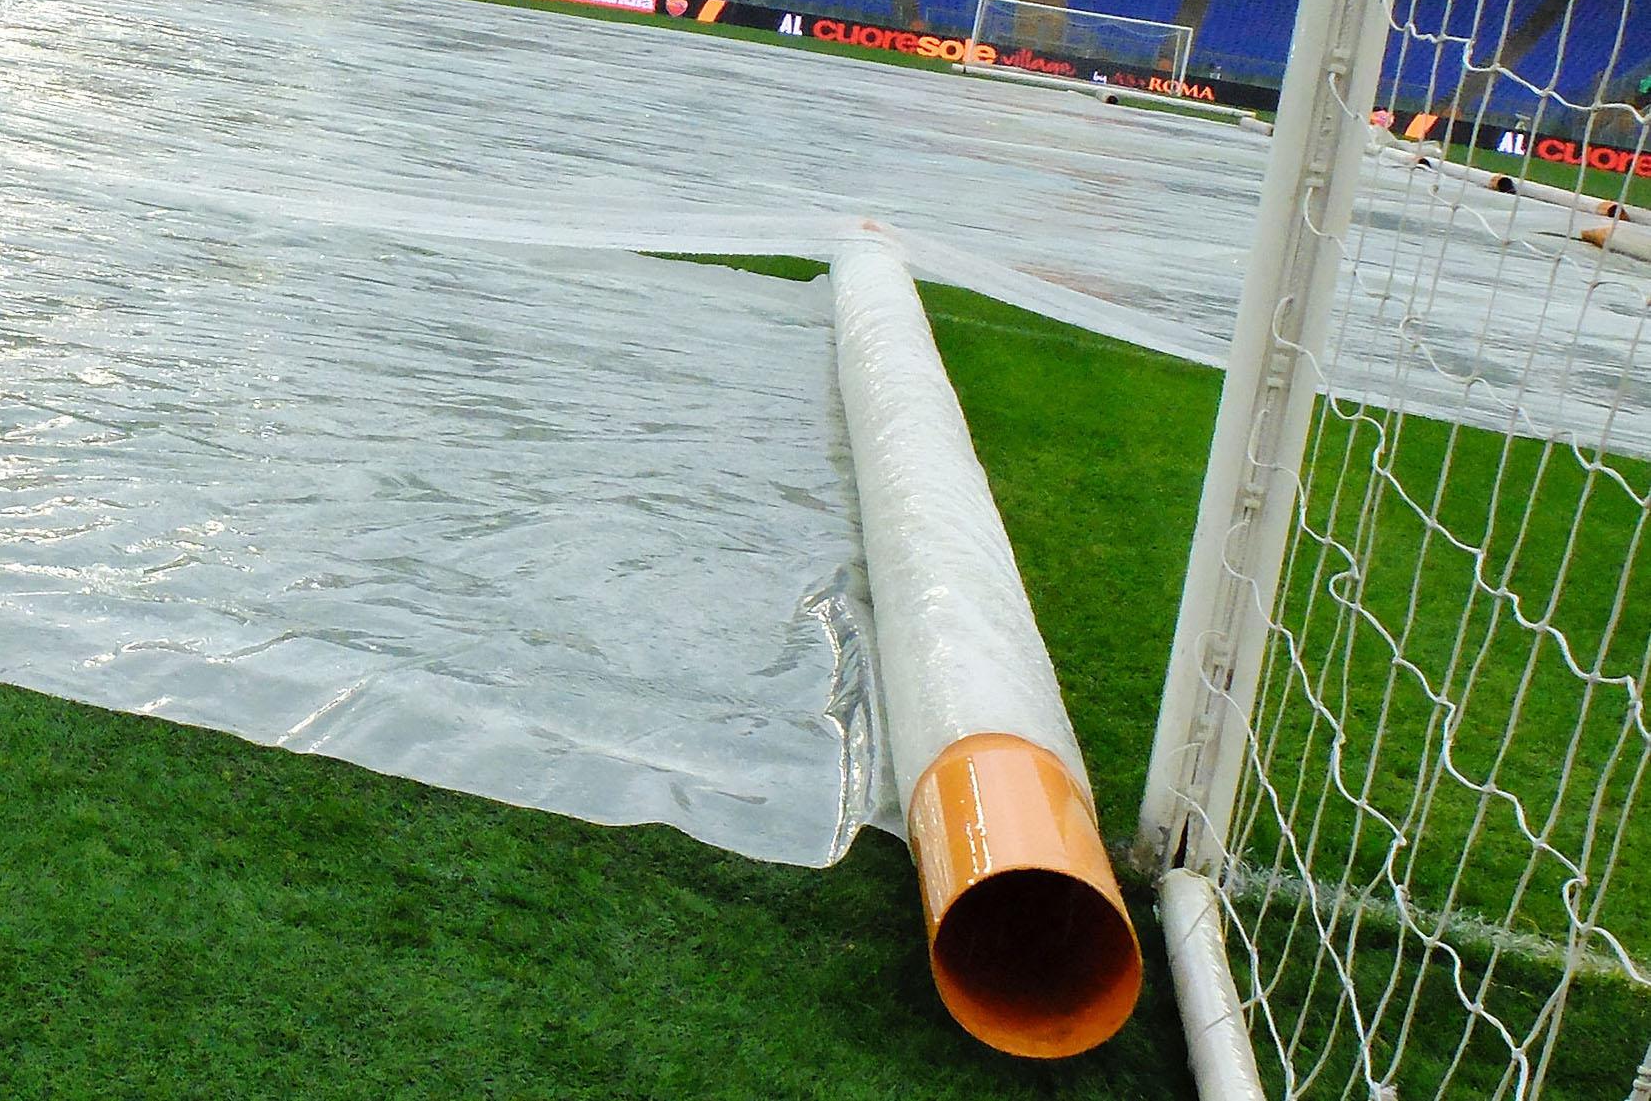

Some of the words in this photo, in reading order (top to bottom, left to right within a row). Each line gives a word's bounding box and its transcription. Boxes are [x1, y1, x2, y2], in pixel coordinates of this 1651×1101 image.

[777, 13, 803, 36] AL
[1149, 76, 1216, 101] ROMA
[1497, 131, 1525, 156] AL
